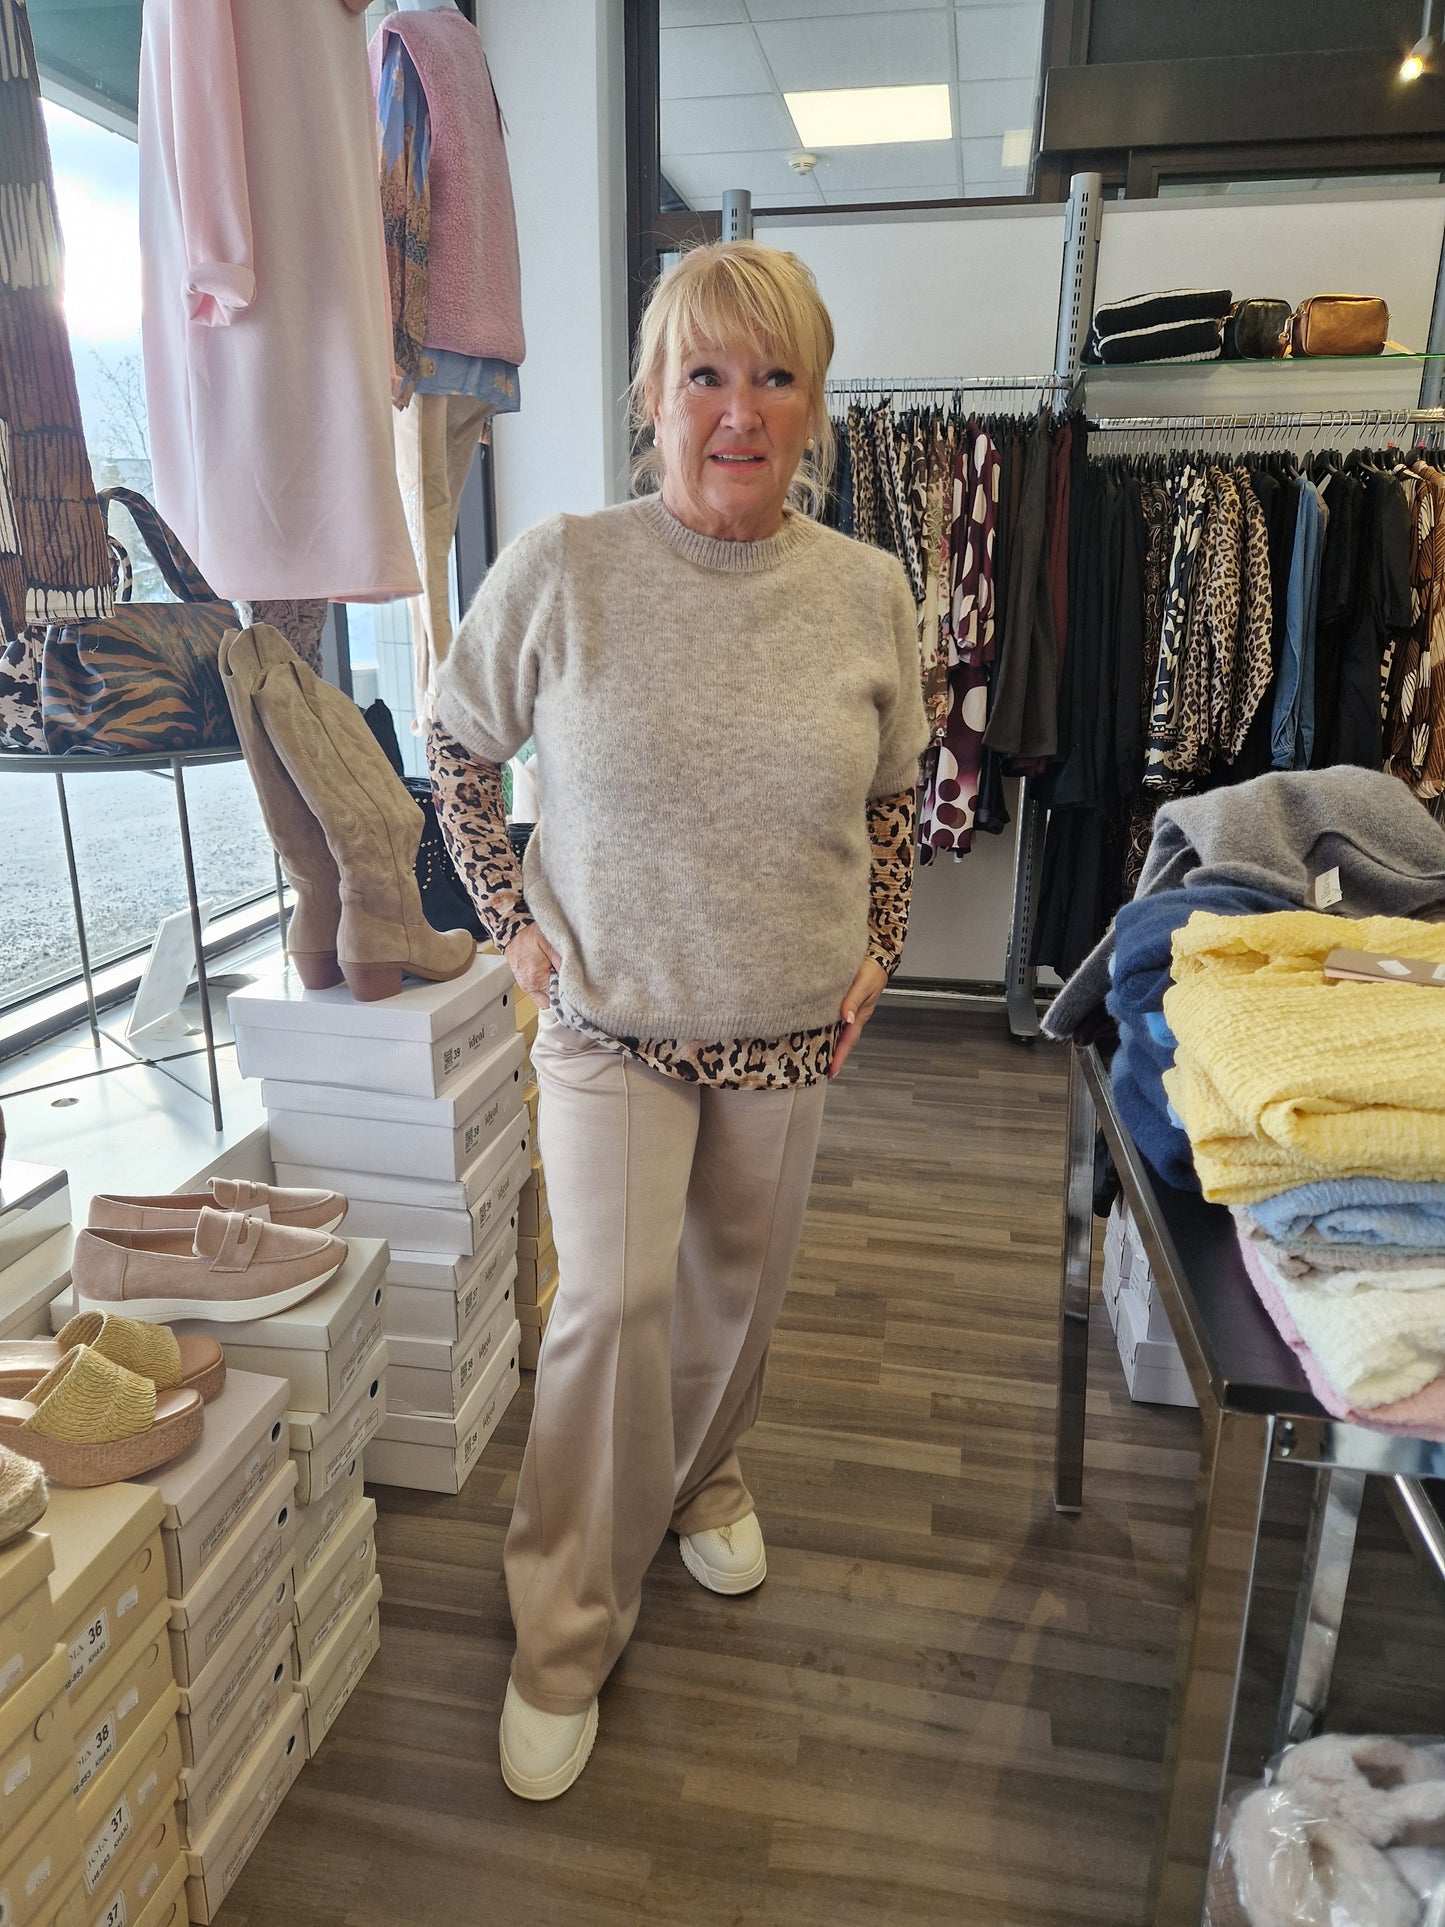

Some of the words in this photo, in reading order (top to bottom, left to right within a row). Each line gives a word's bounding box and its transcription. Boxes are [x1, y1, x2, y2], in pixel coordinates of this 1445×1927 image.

[468, 1027, 485, 1049] ideal
[453, 1047, 461, 1060] 39
[485, 1102, 499, 1126] ideal
[88, 1620, 103, 1645] 36
[88, 1641, 106, 1664] KHAKI
[95, 1724, 109, 1749] 38
[95, 1744, 112, 1768] KHAKI
[110, 1806, 122, 1833] 37
[113, 1823, 129, 1849] KHAKI
[107, 1902, 118, 1927] 37
